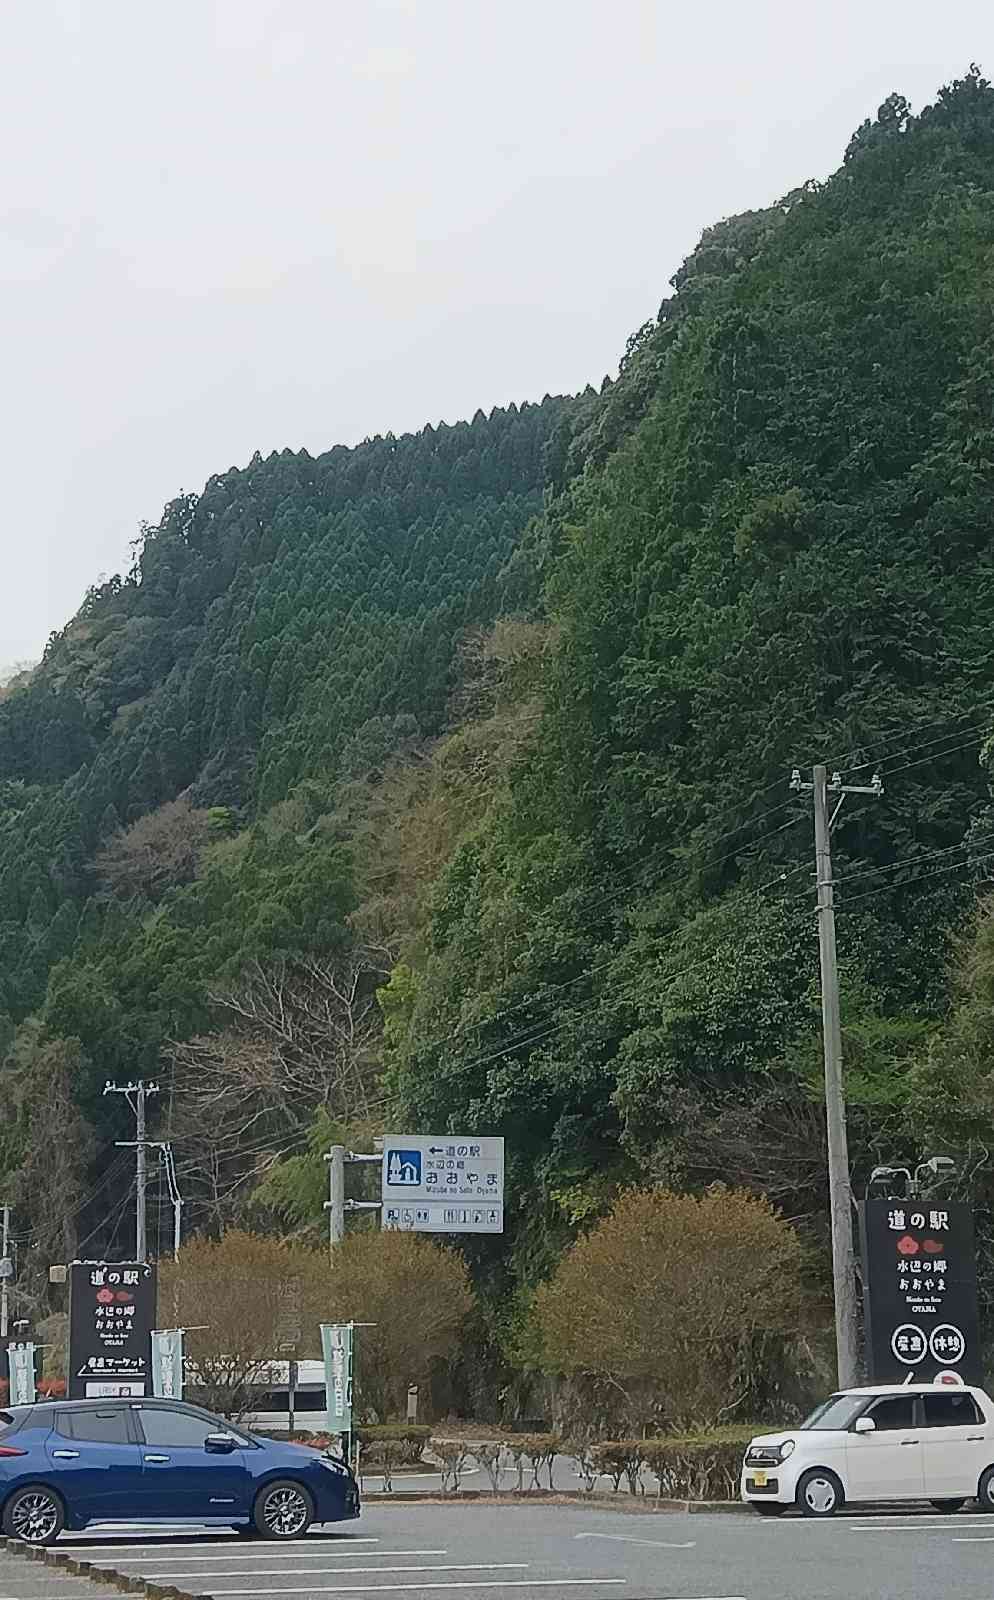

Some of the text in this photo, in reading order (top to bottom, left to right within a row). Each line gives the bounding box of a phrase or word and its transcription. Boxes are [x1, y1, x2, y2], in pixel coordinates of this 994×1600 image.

[446, 1146, 480, 1157] 道の駅
[425, 1172, 498, 1185] おおやま
[888, 1210, 949, 1230] 道の駅
[897, 1260, 947, 1273] 水辺の郷
[90, 1269, 139, 1286] 道の駅
[899, 1278, 946, 1291] おおやま
